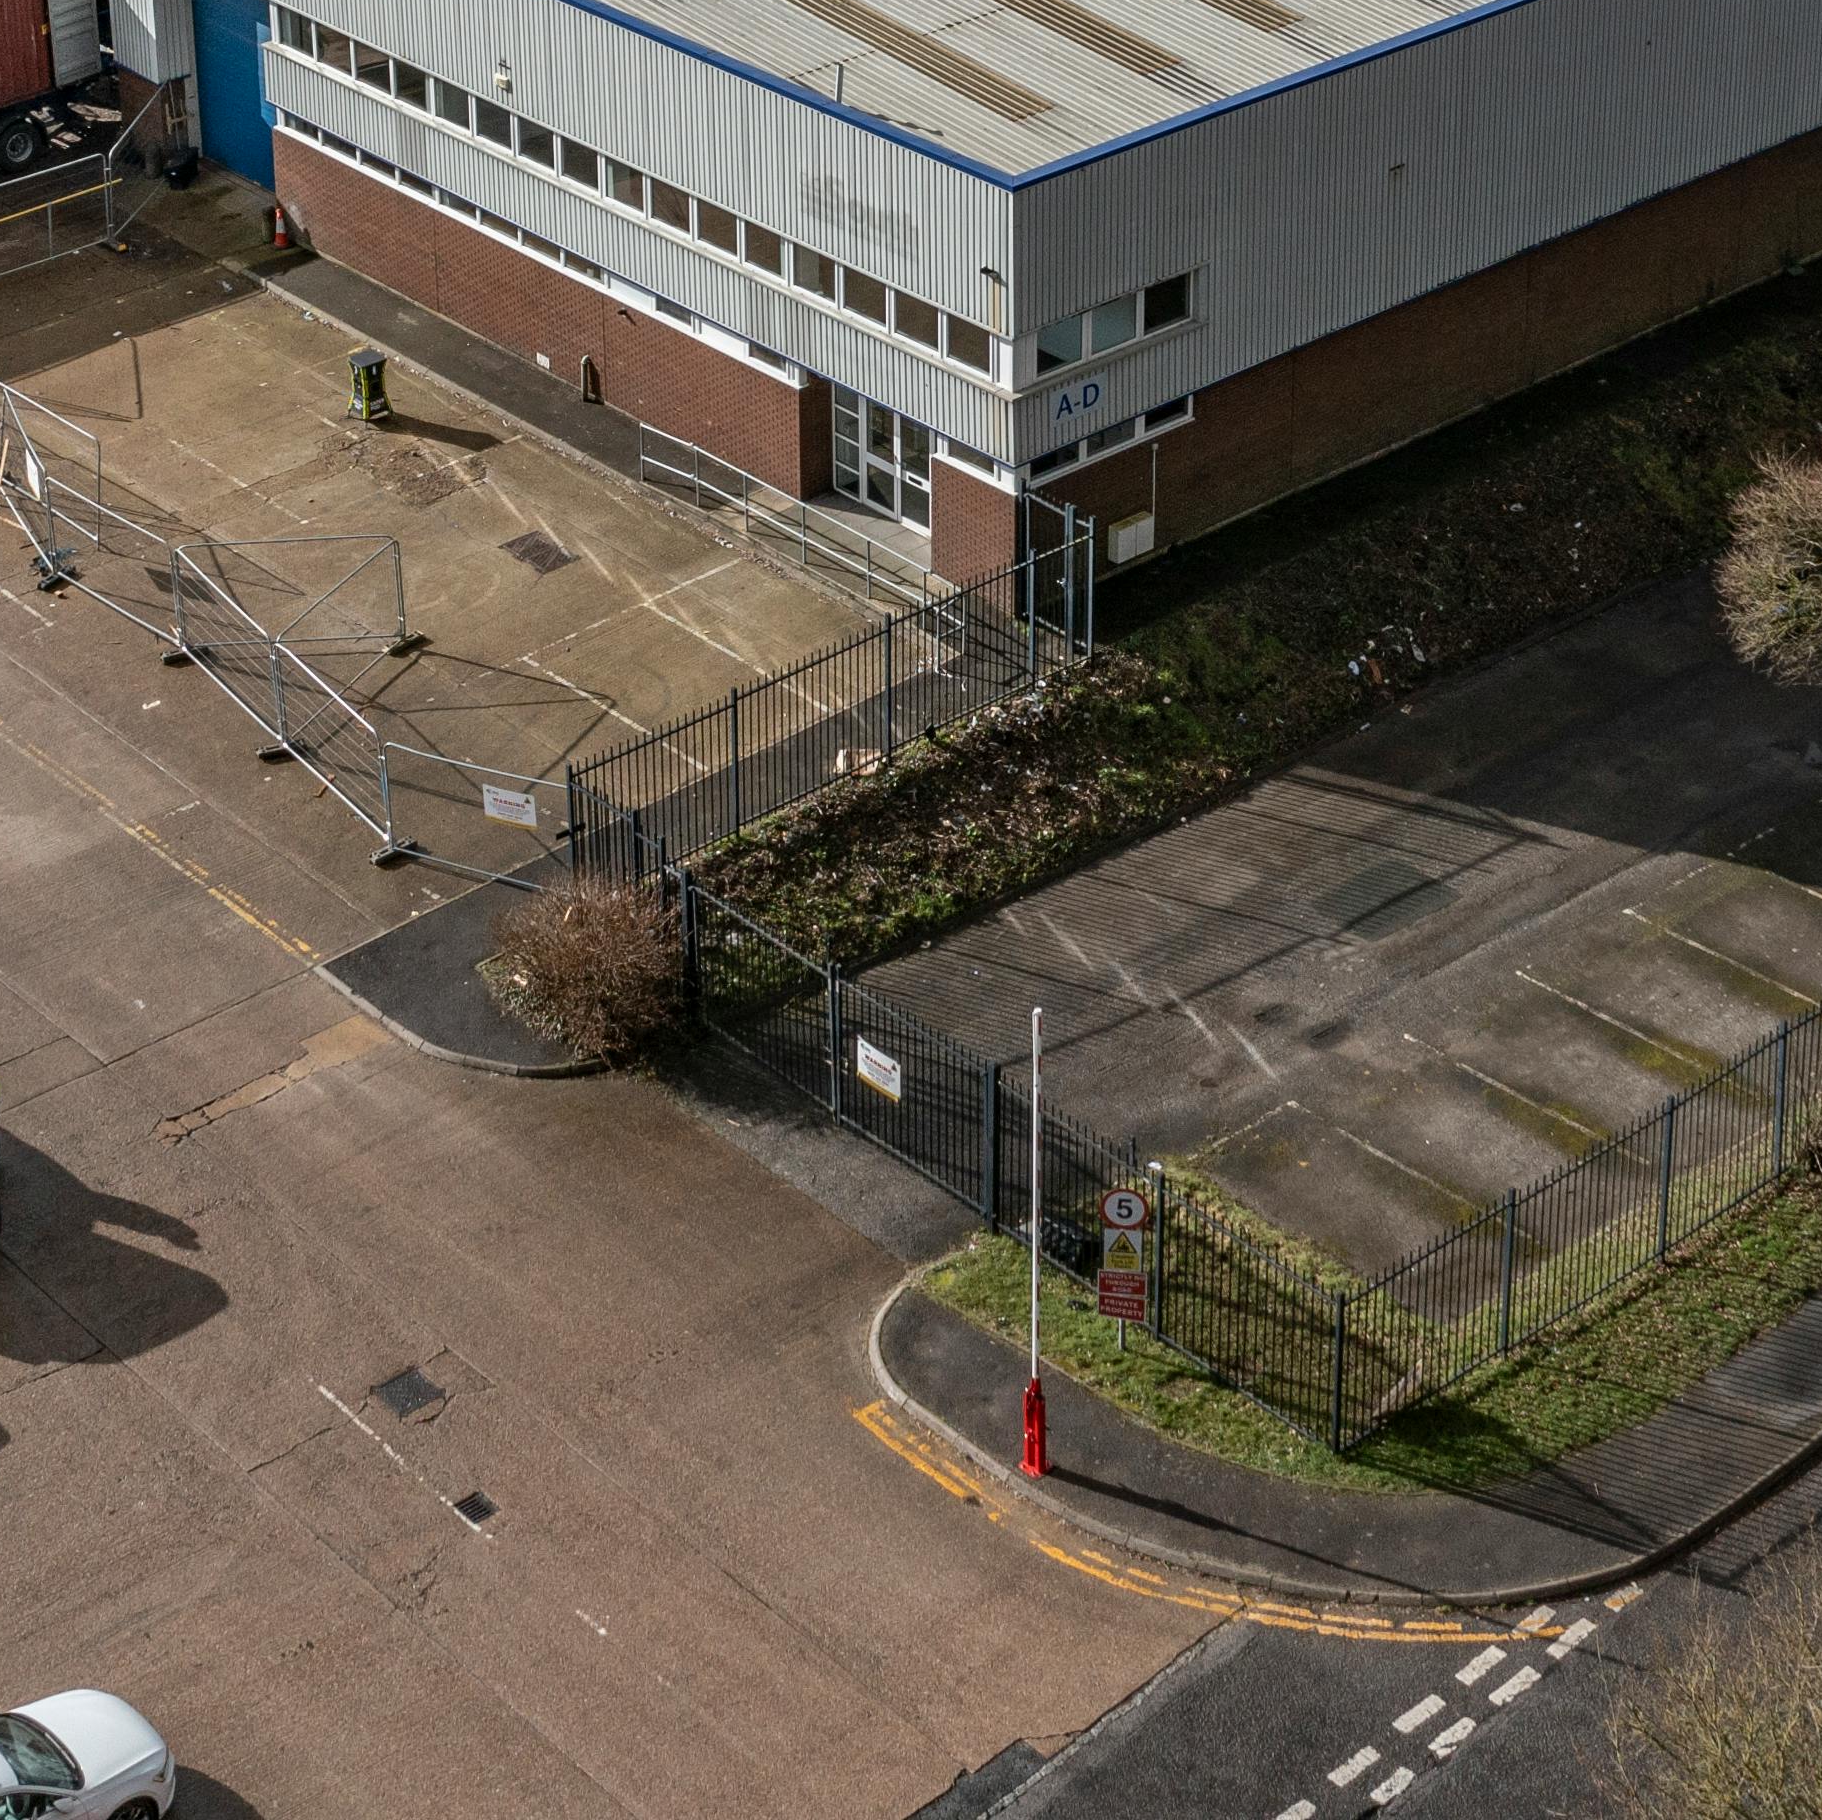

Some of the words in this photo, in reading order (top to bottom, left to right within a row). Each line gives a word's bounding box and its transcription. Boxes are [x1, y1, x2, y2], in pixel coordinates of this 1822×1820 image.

[1055, 383, 1100, 420] A-D
[492, 796, 526, 810] WARNING
[1116, 1198, 1133, 1219] 5
[1104, 1298, 1139, 1309] PRIVATE
[1100, 1305, 1143, 1318] PROPERTY
